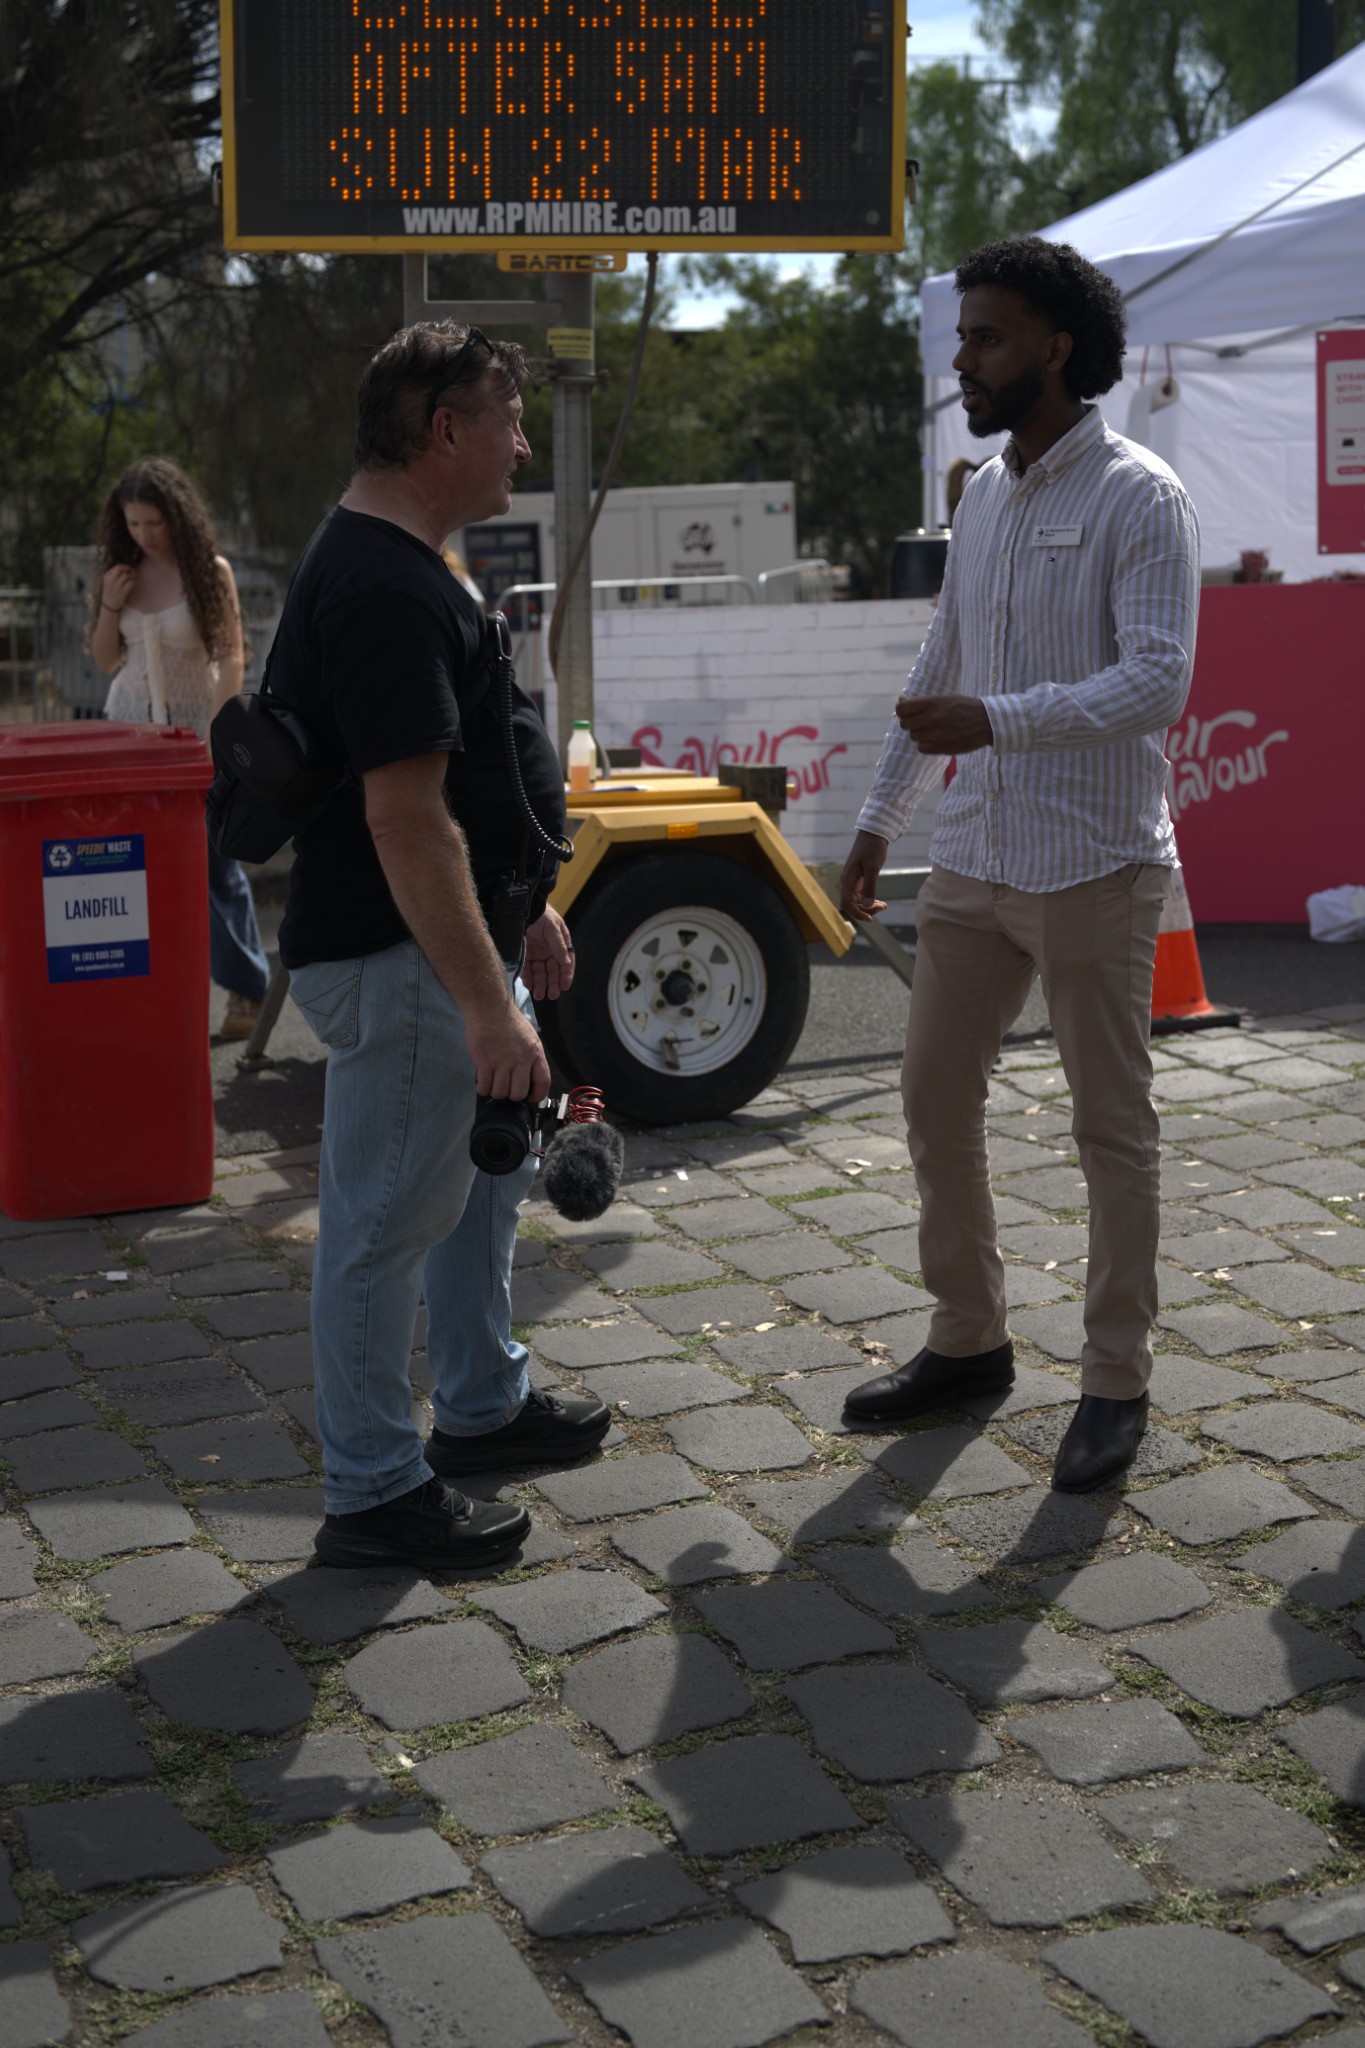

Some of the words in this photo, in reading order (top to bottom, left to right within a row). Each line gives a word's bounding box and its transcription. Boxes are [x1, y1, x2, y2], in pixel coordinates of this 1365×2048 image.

[353, 42, 575, 115] AFTER
[330, 127, 491, 200] SUN
[531, 127, 610, 200] 22
[651, 127, 801, 200] MAR
[402, 202, 736, 234] www.RPMHIRE.com.au
[509, 254, 615, 270] BARTCO
[1166, 730, 1289, 821] lavour
[76, 842, 106, 856] SPEEDIE
[107, 840, 132, 853] WASTE
[65, 896, 129, 921] LANDFILL
